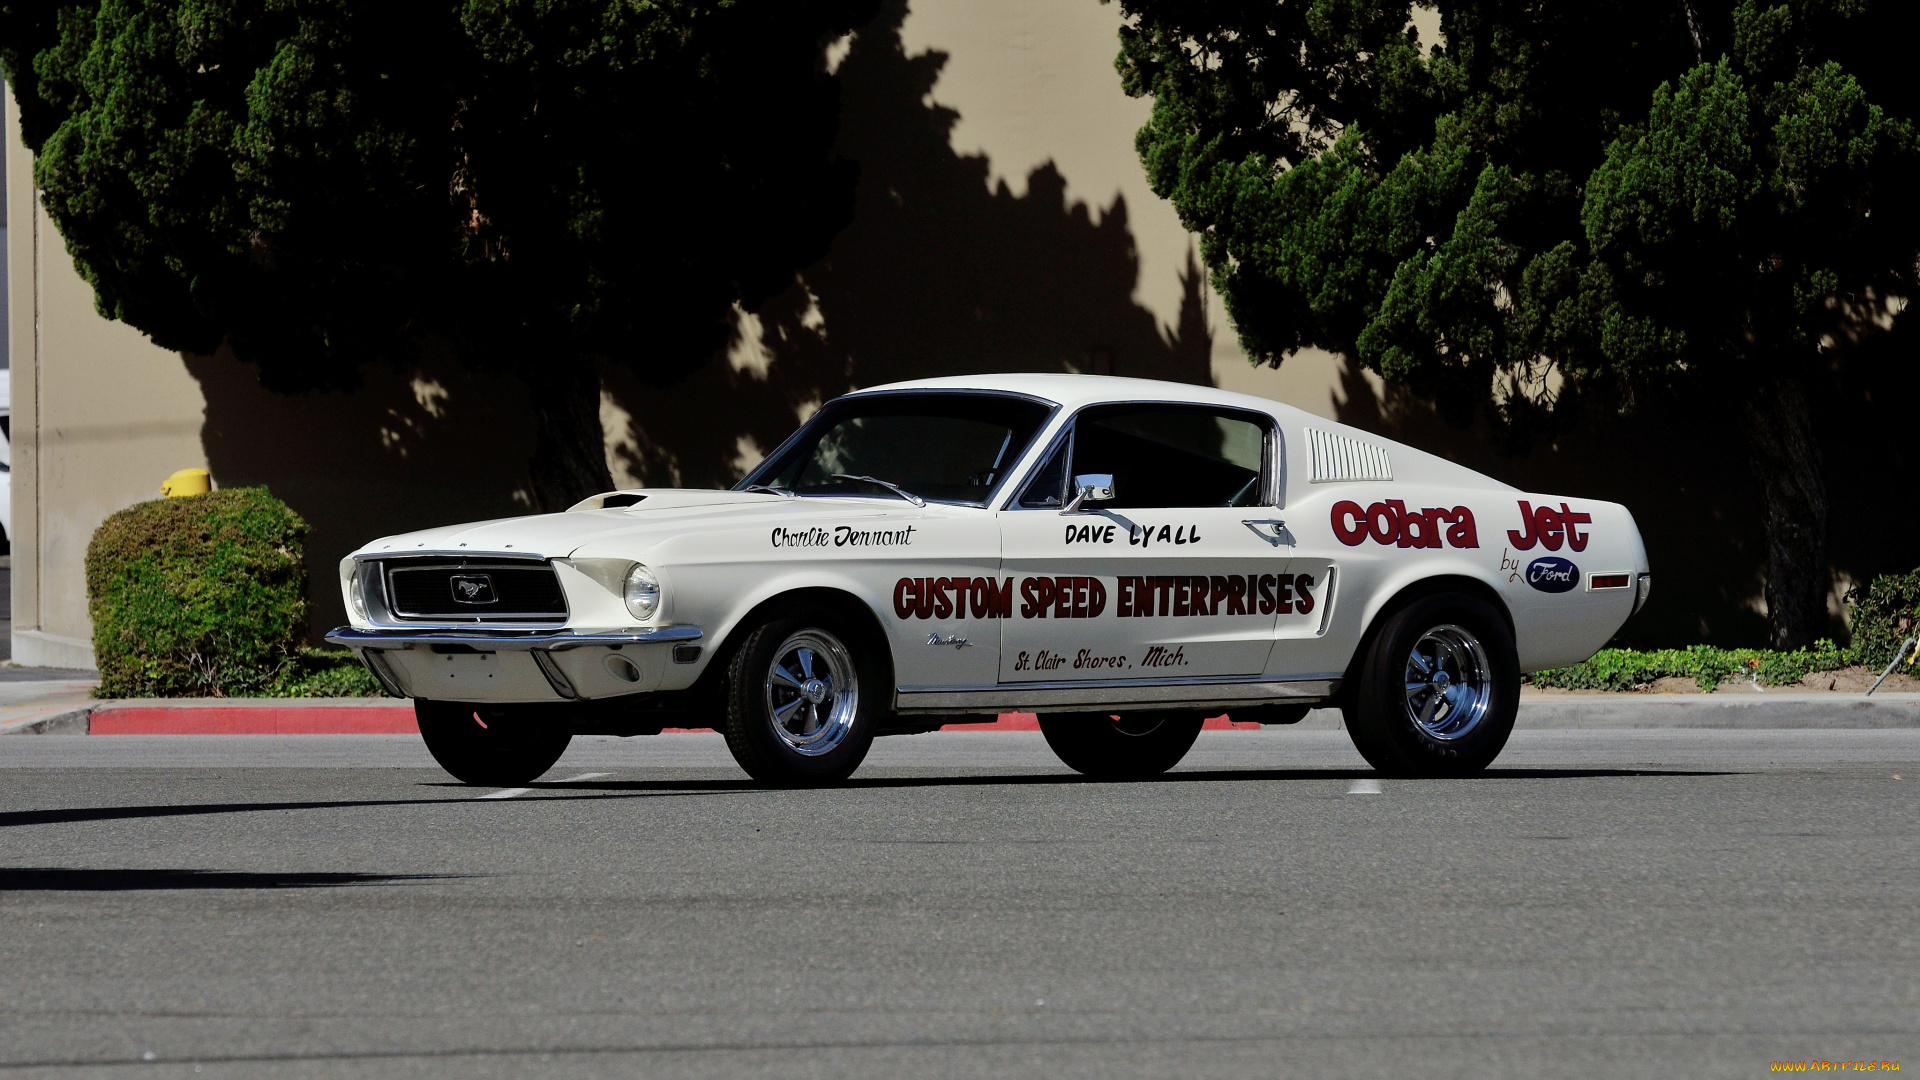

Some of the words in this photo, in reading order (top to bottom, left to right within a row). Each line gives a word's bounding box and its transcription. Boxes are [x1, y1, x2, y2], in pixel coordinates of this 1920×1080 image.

[771, 527, 830, 548] Charlie
[1065, 525, 1116, 544] DAVE
[1129, 525, 1201, 548] LYALL
[1330, 499, 1480, 549] Cobra
[1507, 500, 1592, 552] Jet
[1500, 548, 1525, 584] by
[1530, 562, 1573, 583] Ford
[893, 577, 1015, 620] CUSTOM
[1020, 577, 1107, 619] SPEED
[1117, 574, 1315, 617] ENTERPRISES
[1014, 651, 1031, 671] St.
[1034, 650, 1067, 670] Clair
[1141, 646, 1189, 667] Mich.
